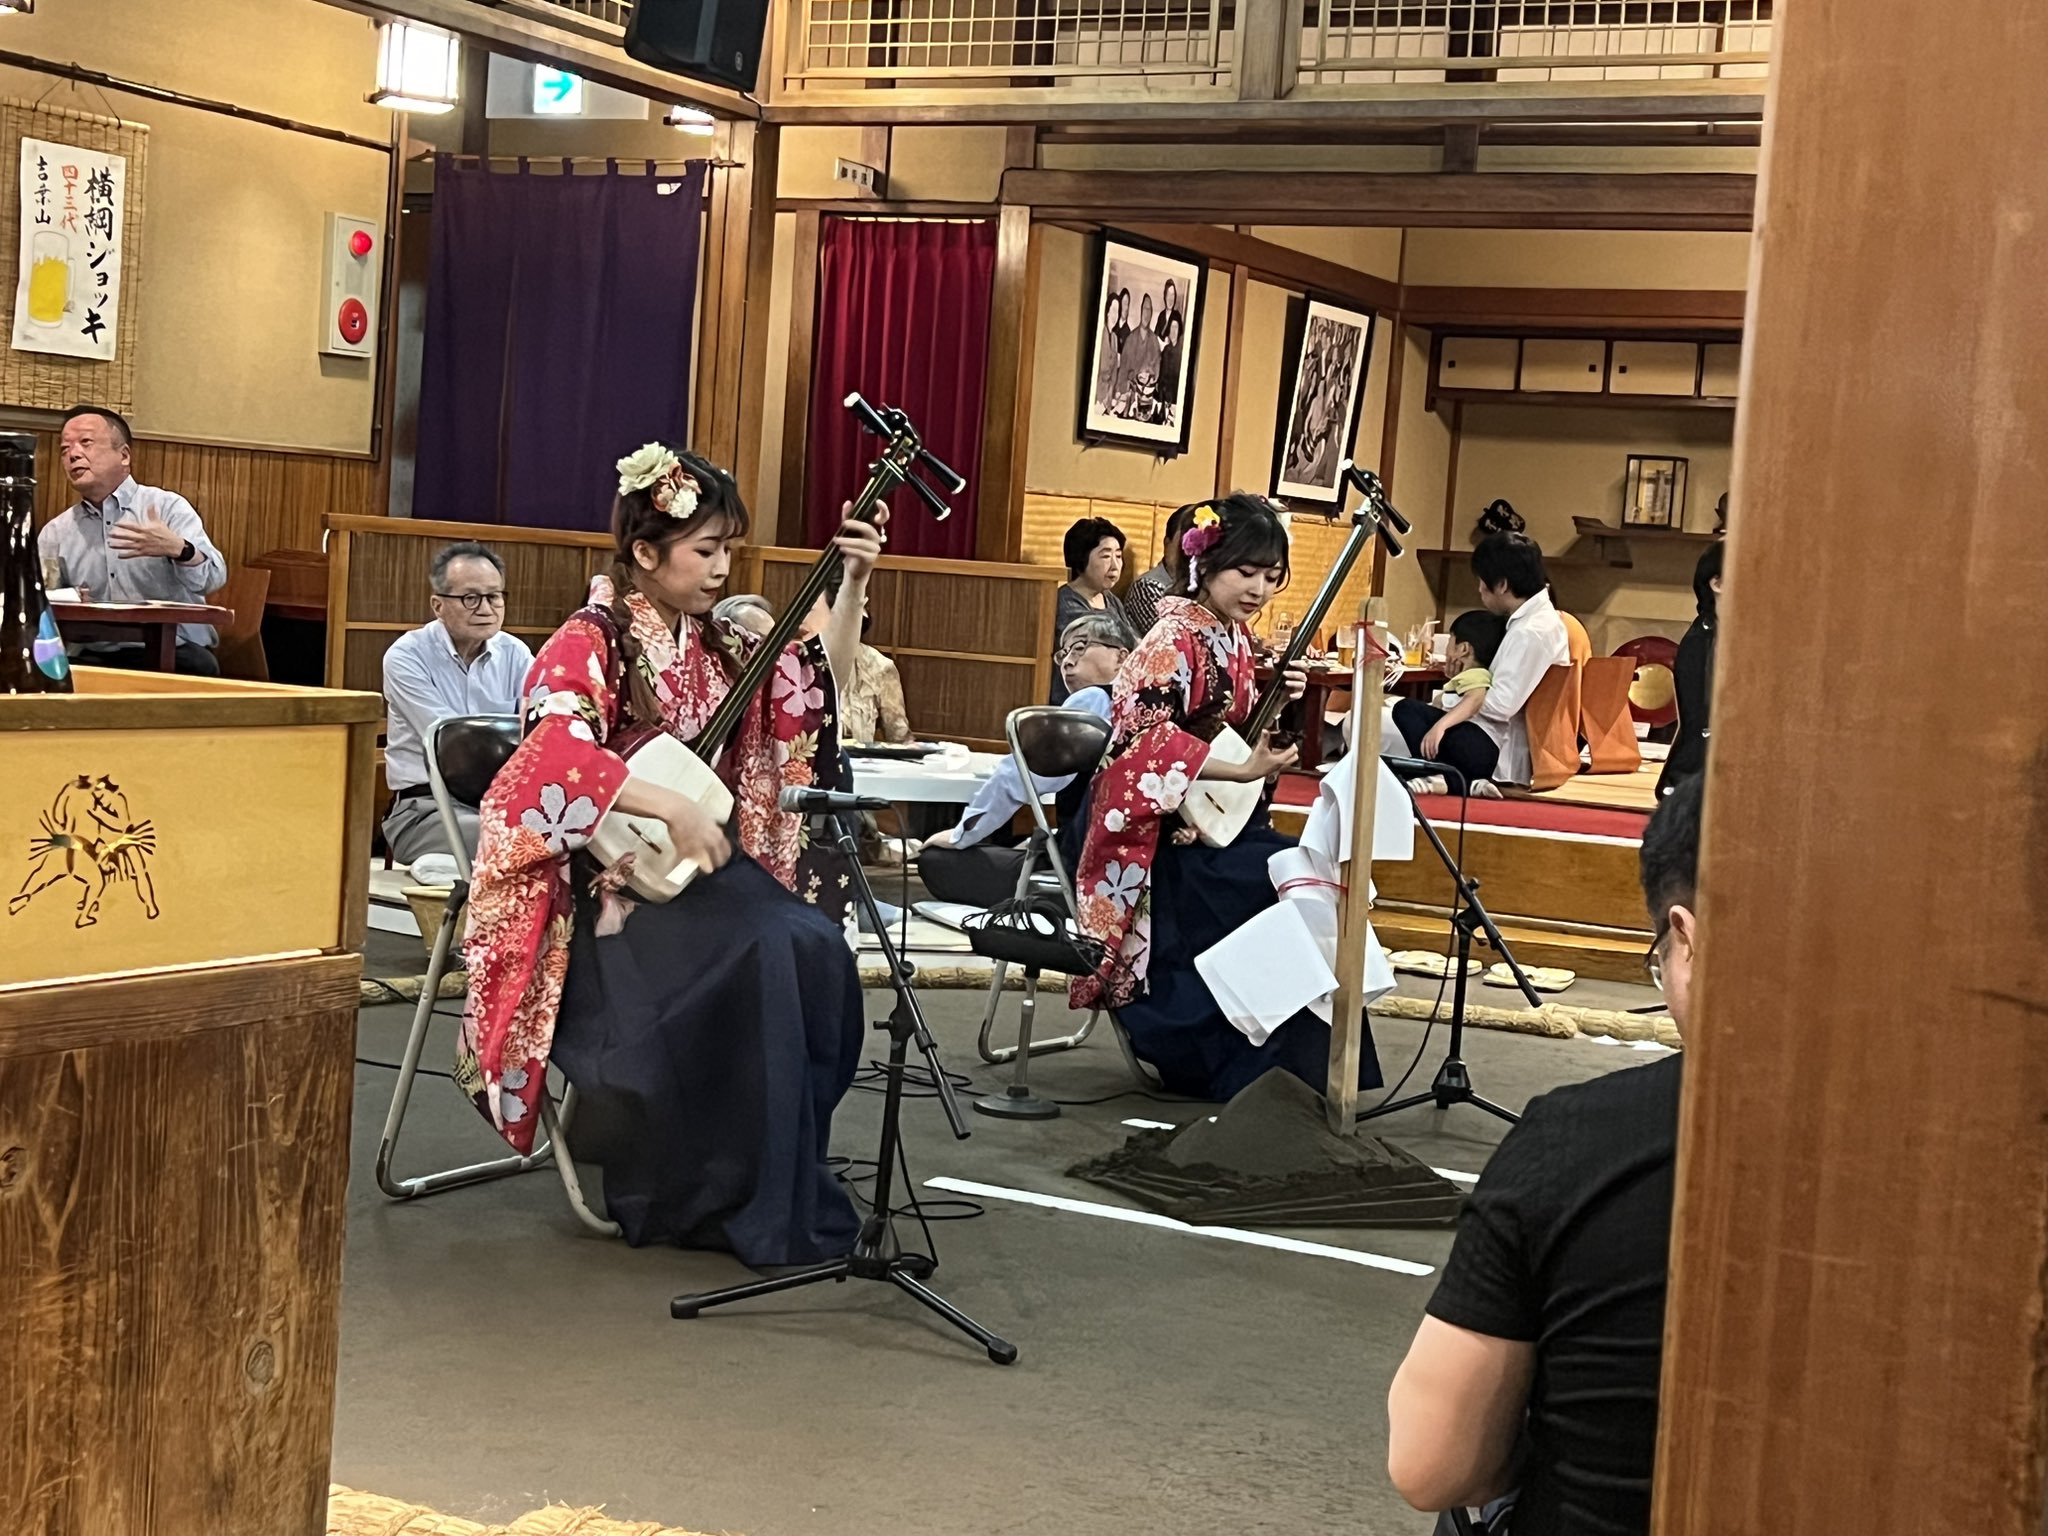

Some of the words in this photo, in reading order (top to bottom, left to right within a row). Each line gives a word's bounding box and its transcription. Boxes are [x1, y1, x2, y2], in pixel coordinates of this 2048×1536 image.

[59, 164, 79, 234] 四十三代
[81, 166, 115, 344] 横綱ジョッキ
